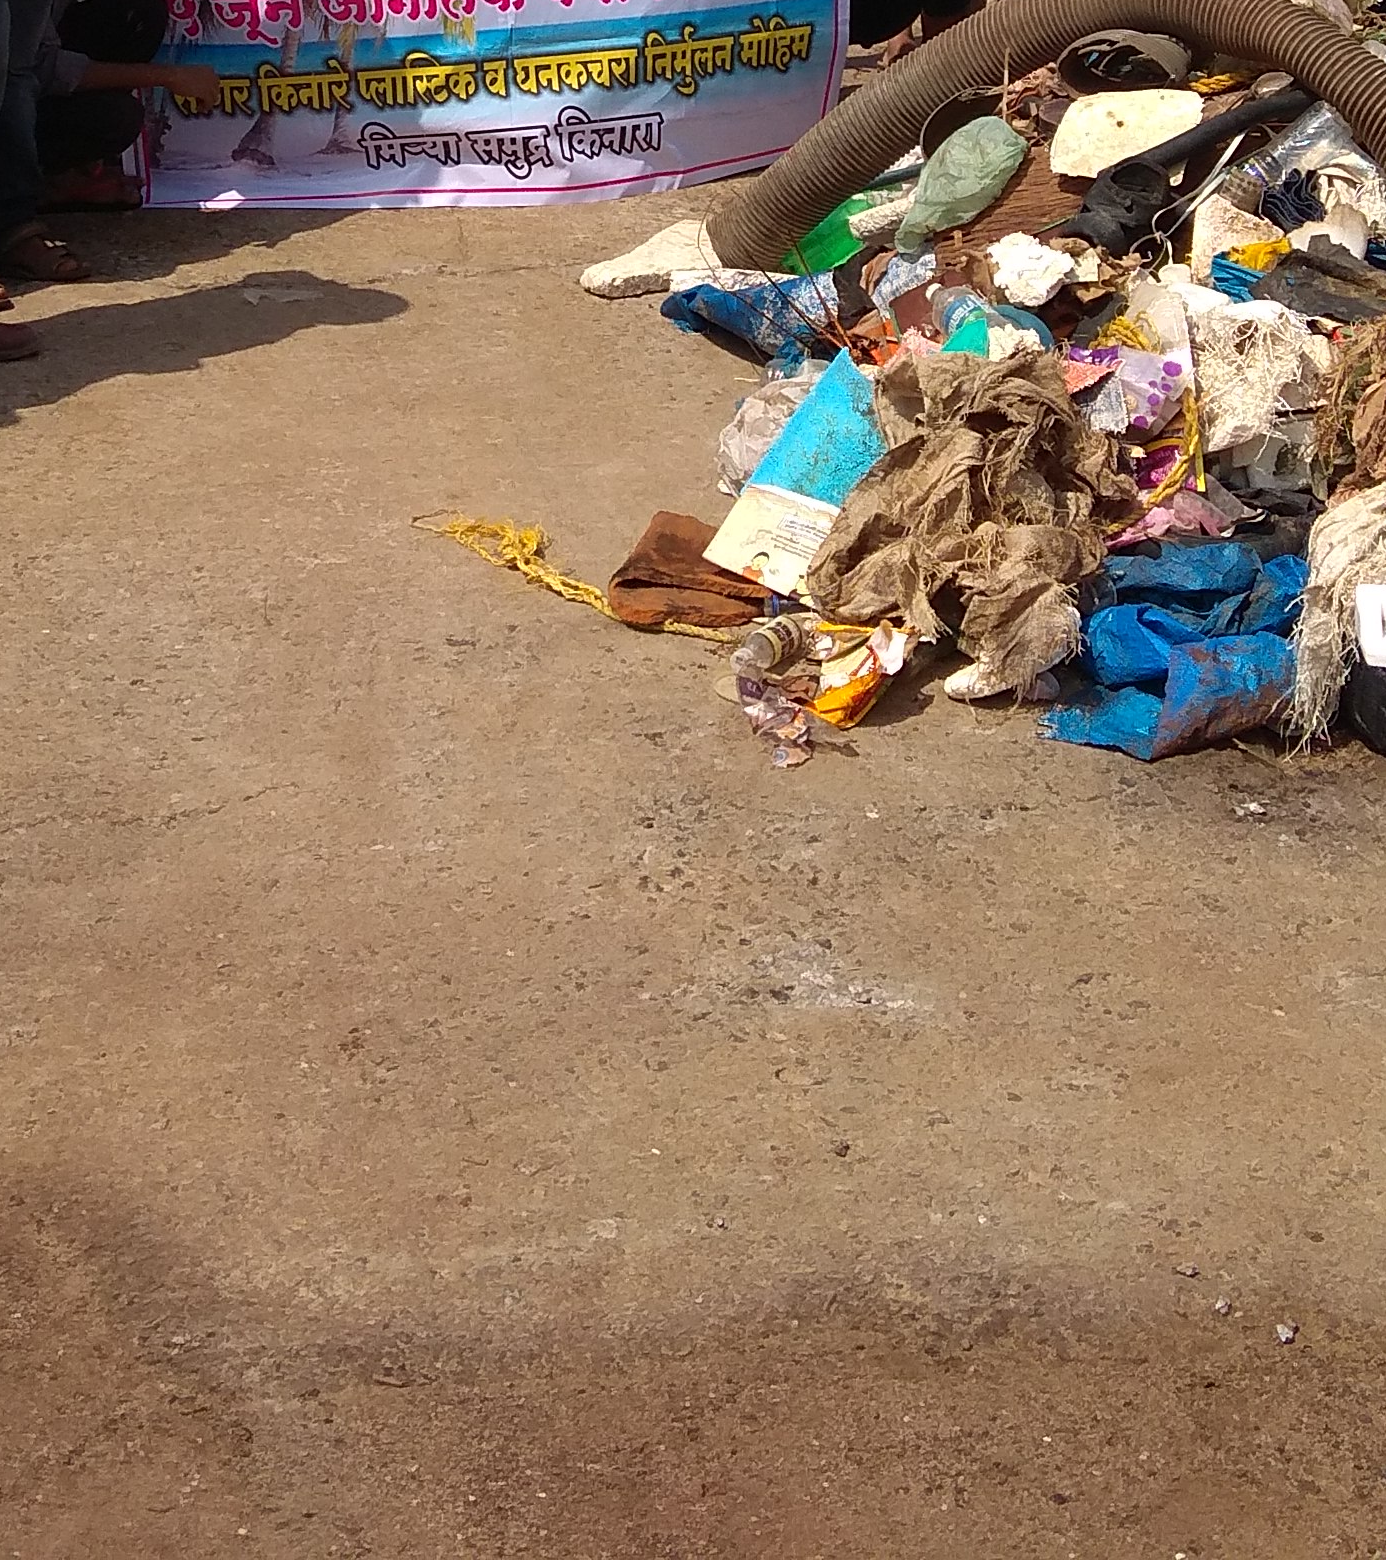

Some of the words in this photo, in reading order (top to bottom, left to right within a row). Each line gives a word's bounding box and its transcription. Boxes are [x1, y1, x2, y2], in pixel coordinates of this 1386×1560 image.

[257, 59, 351, 113] किनारे
[357, 52, 476, 108] प्लास्टिक
[484, 59, 507, 97] व
[514, 47, 639, 95] घनकचरा
[646, 25, 734, 96] निर्मुलन
[739, 17, 812, 71] मोहिम
[466, 126, 553, 180] समुद्र
[556, 106, 664, 163] किनारा
